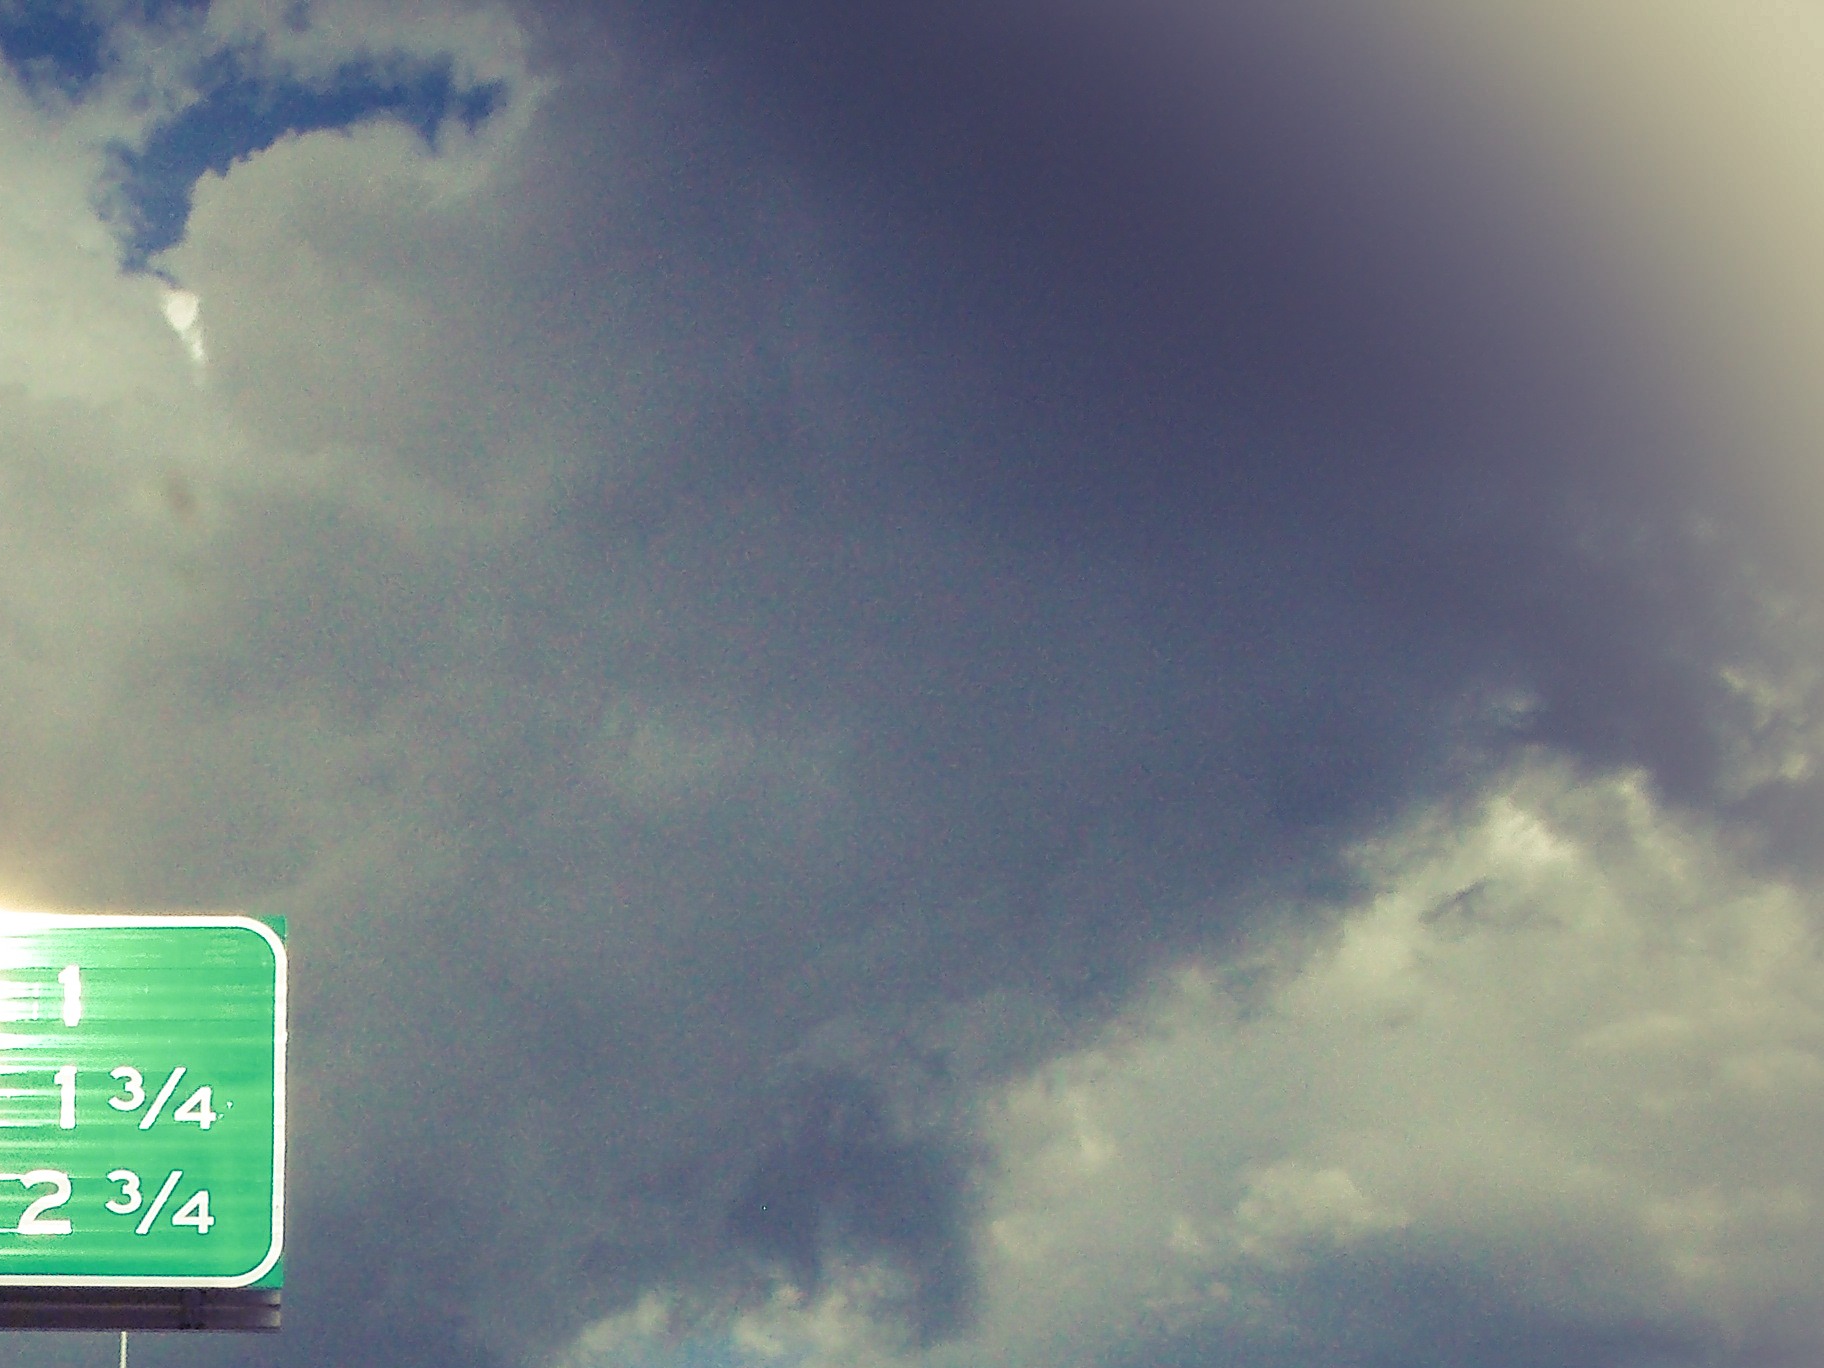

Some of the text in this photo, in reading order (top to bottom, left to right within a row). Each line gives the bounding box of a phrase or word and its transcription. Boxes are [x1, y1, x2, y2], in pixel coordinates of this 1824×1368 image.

[58, 965, 81, 1027] 1
[54, 1066, 77, 1129] 1
[17, 1170, 72, 1235] 2
